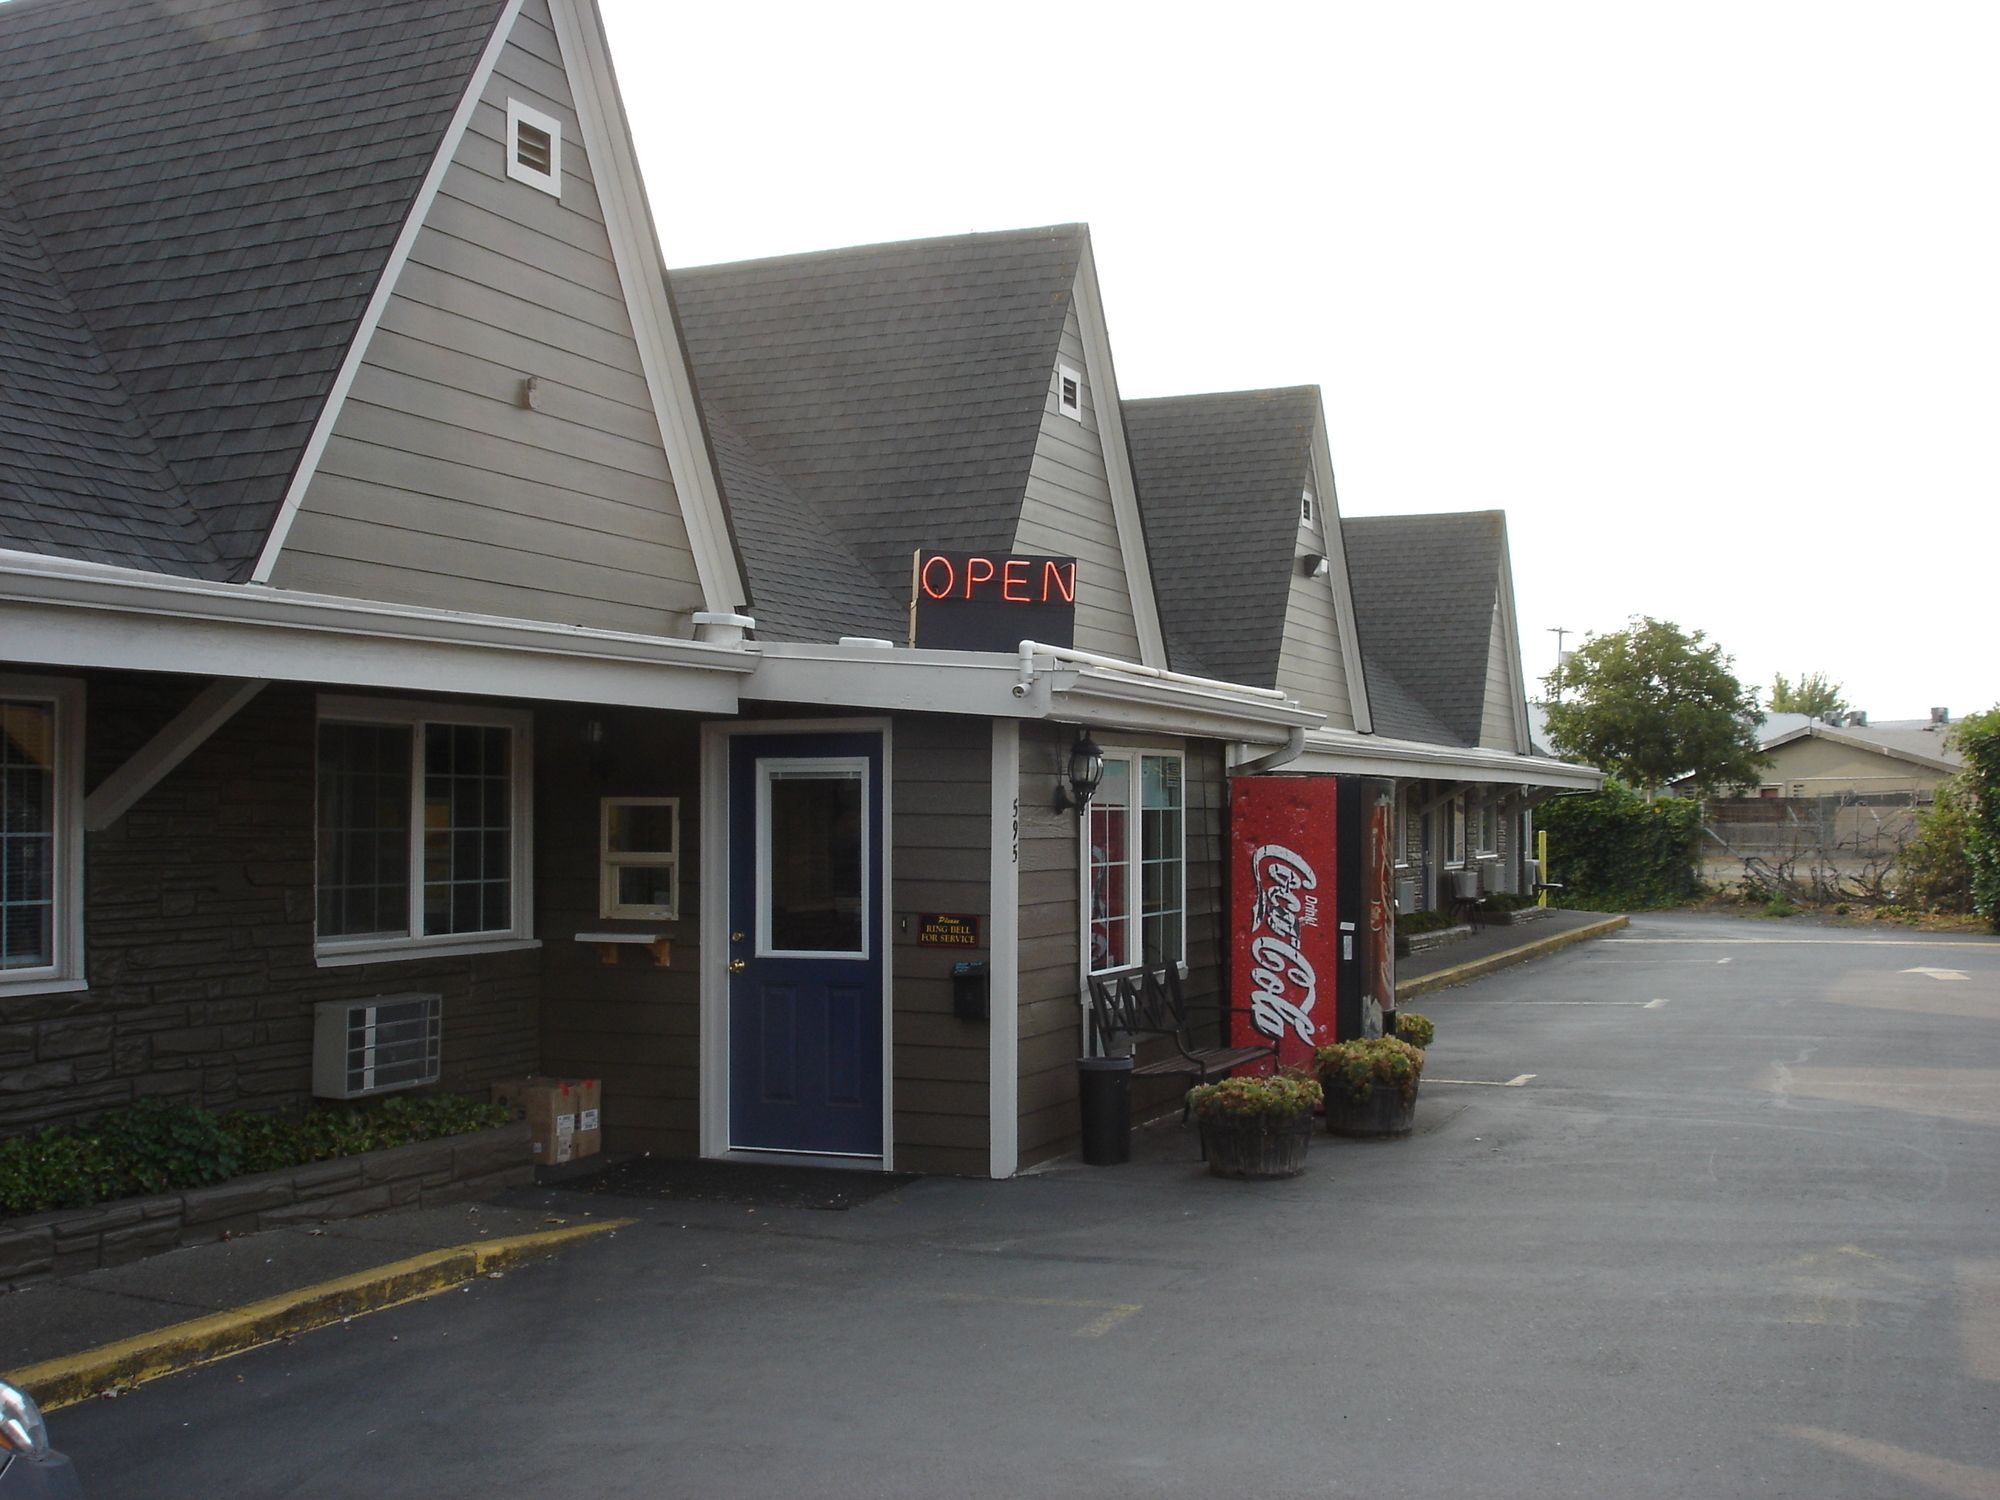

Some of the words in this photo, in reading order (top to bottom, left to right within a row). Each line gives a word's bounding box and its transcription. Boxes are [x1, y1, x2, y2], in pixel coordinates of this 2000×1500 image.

[922, 556, 1076, 602] OPEN
[1011, 798, 1019, 863] 595
[926, 925, 948, 933] RING
[950, 926, 970, 934] BELL
[1304, 895, 1318, 928] Drink!
[921, 934, 938, 942] FOR
[940, 935, 975, 944] SERVICE
[1251, 844, 1317, 1047] Coca-Cola
